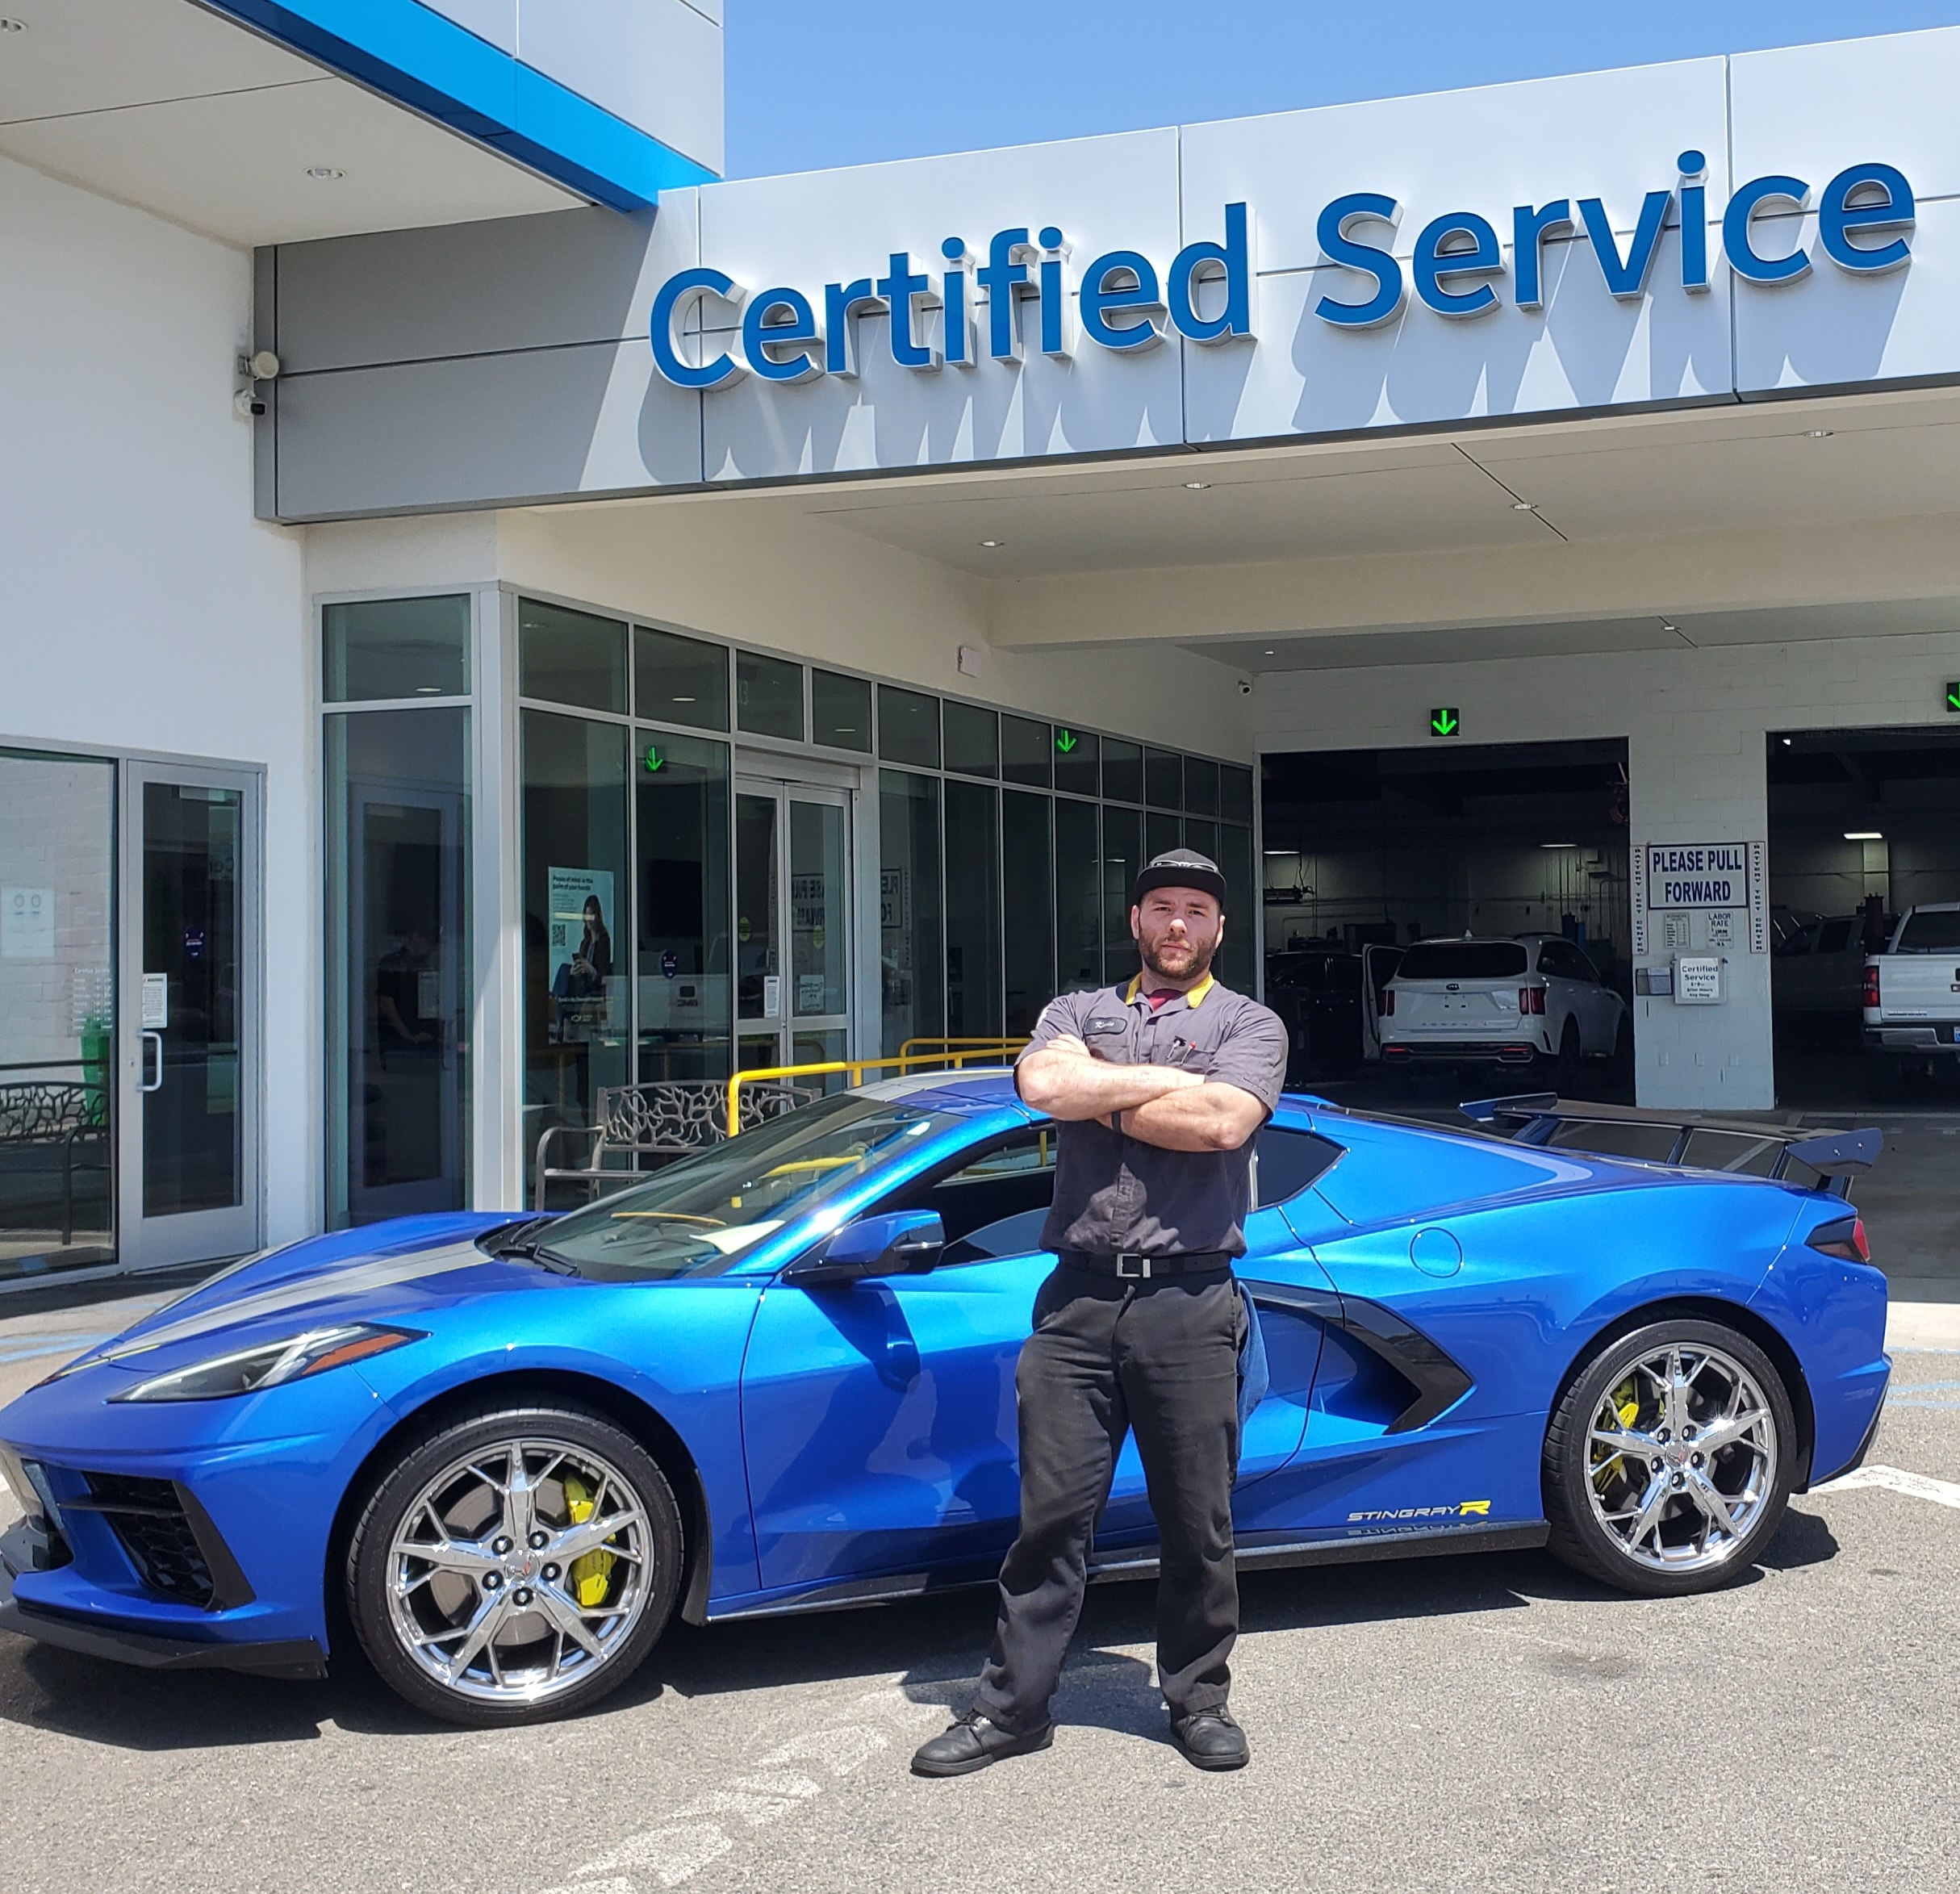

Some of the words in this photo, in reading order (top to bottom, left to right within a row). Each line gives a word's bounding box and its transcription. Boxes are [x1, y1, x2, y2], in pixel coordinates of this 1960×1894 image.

[650, 201, 1247, 391] Certified
[1314, 149, 1916, 327] Service
[1653, 851, 1703, 872] PLEASE
[1707, 850, 1742, 871] PULL
[1665, 880, 1731, 902] FORWARD
[1348, 1505, 1461, 1522] STINGRAY
